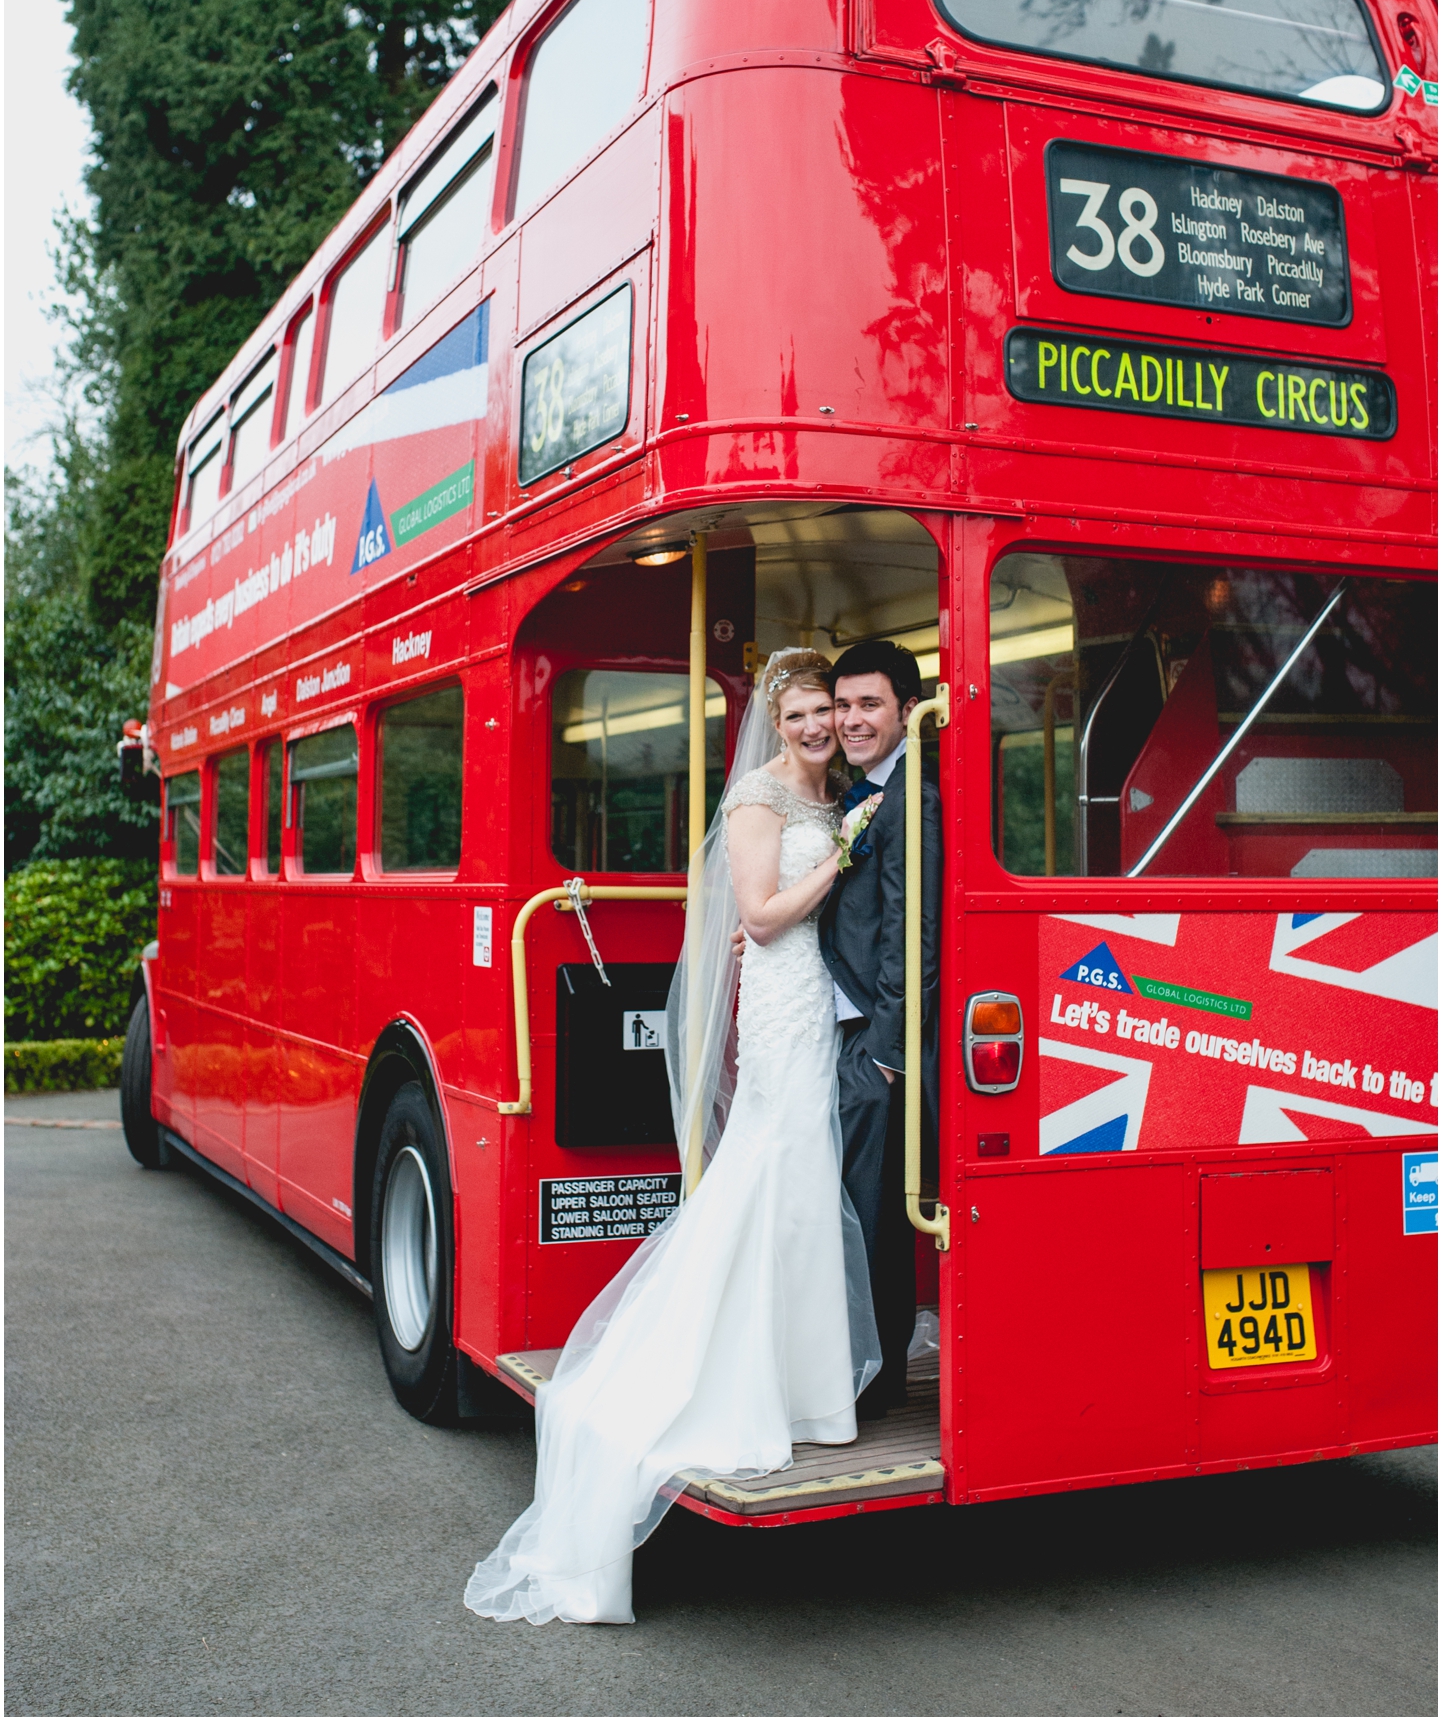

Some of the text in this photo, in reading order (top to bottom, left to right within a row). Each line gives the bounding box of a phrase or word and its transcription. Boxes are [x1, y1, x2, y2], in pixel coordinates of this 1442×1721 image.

[1190, 186, 1304, 223] Hackney Dalston
[1060, 178, 1165, 277] 38
[1171, 212, 1324, 256] Islington Rosebery Ave
[1178, 242, 1323, 288] Bloomsbury Piccadilly
[1198, 274, 1311, 308] Hyde Park Corner
[531, 358, 565, 453] 38
[1038, 341, 1370, 430] PICCADILLY CIRCUS
[398, 475, 470, 535] GLOBAL LOGISTICS LTD
[234, 564, 270, 617] business
[270, 552, 280, 593] to
[281, 541, 293, 586] do
[293, 528, 310, 578] it's
[311, 512, 336, 566] duty
[358, 524, 385, 568] P.G.S.
[392, 630, 432, 665] Hackney
[296, 661, 350, 702] Dalston Junction
[1077, 964, 1122, 990] P.G.S.
[1146, 984, 1246, 1015] GLOBAL LOGISTICS LTD
[1050, 993, 1111, 1034] Let's
[1116, 1009, 1180, 1049] trade
[1185, 1030, 1297, 1075] ourselves
[1301, 1050, 1359, 1089] back
[1362, 1064, 1384, 1094] to
[1389, 1070, 1425, 1104] the
[551, 1178, 668, 1195] PASSENGER CAPACITY
[551, 1192, 676, 1210] UPPER SALOON SEATED
[1409, 1192, 1436, 1204] Keep
[551, 1211, 590, 1225] LOWER
[593, 1208, 636, 1223] SALOON
[551, 1225, 604, 1239] STANDING
[607, 1223, 644, 1236] LOWER
[1226, 1271, 1290, 1313] JJD
[1218, 1312, 1306, 1357] 494D
